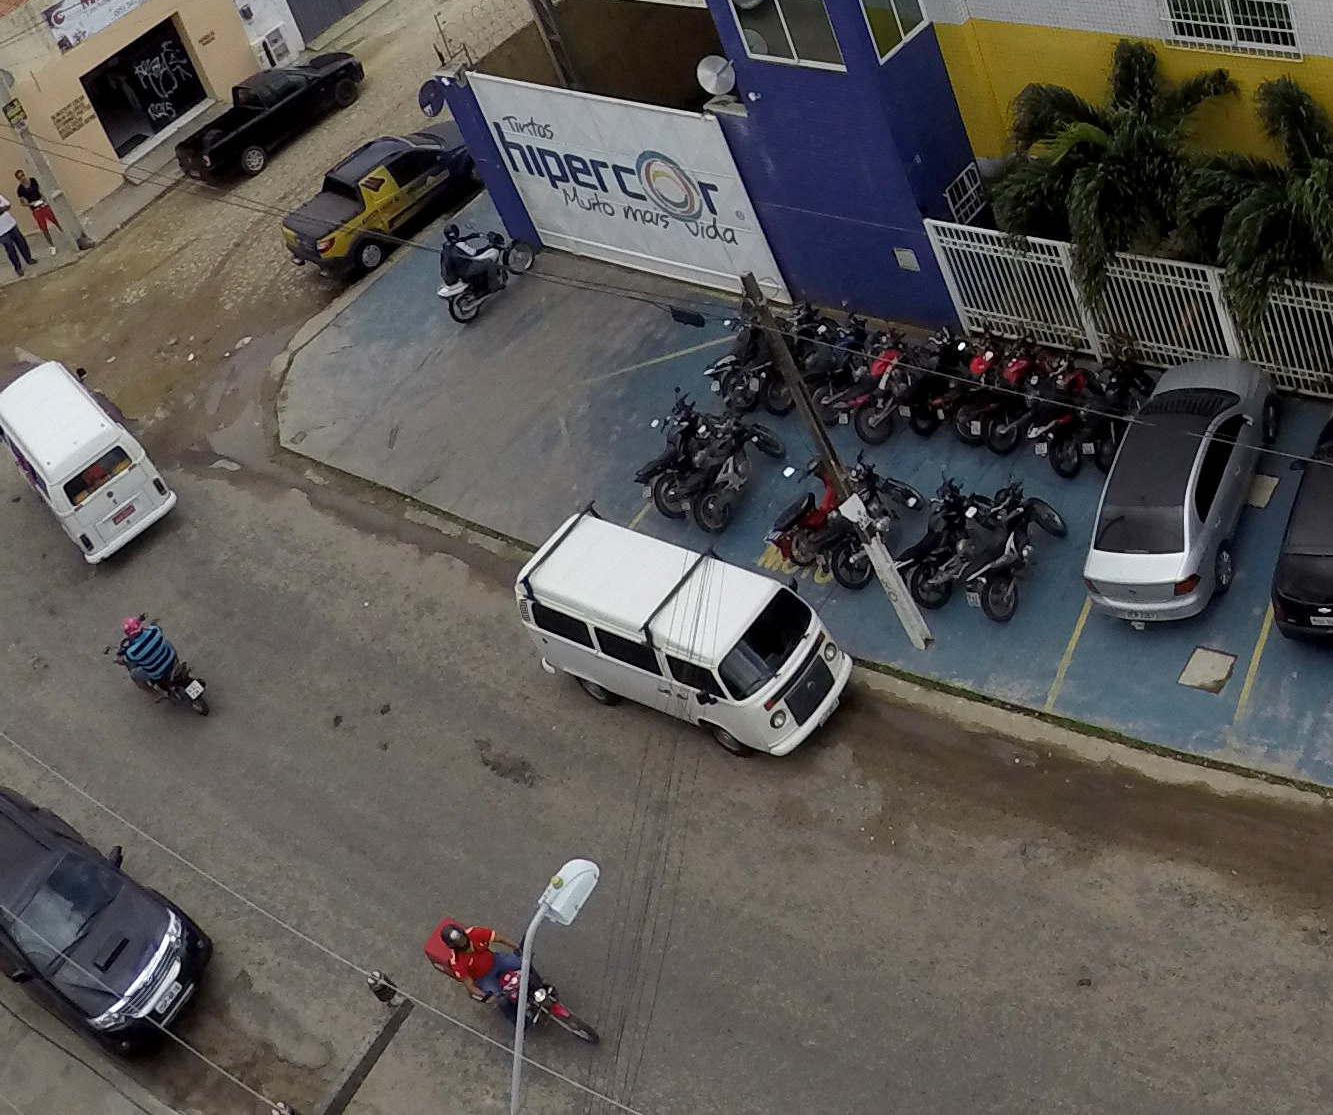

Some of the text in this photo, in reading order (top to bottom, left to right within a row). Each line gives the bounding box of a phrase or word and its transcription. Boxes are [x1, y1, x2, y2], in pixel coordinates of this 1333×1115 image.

[502, 115, 555, 140] Tintas
[493, 121, 719, 222] hipercor
[562, 187, 615, 218] Muito
[622, 204, 670, 230] mais
